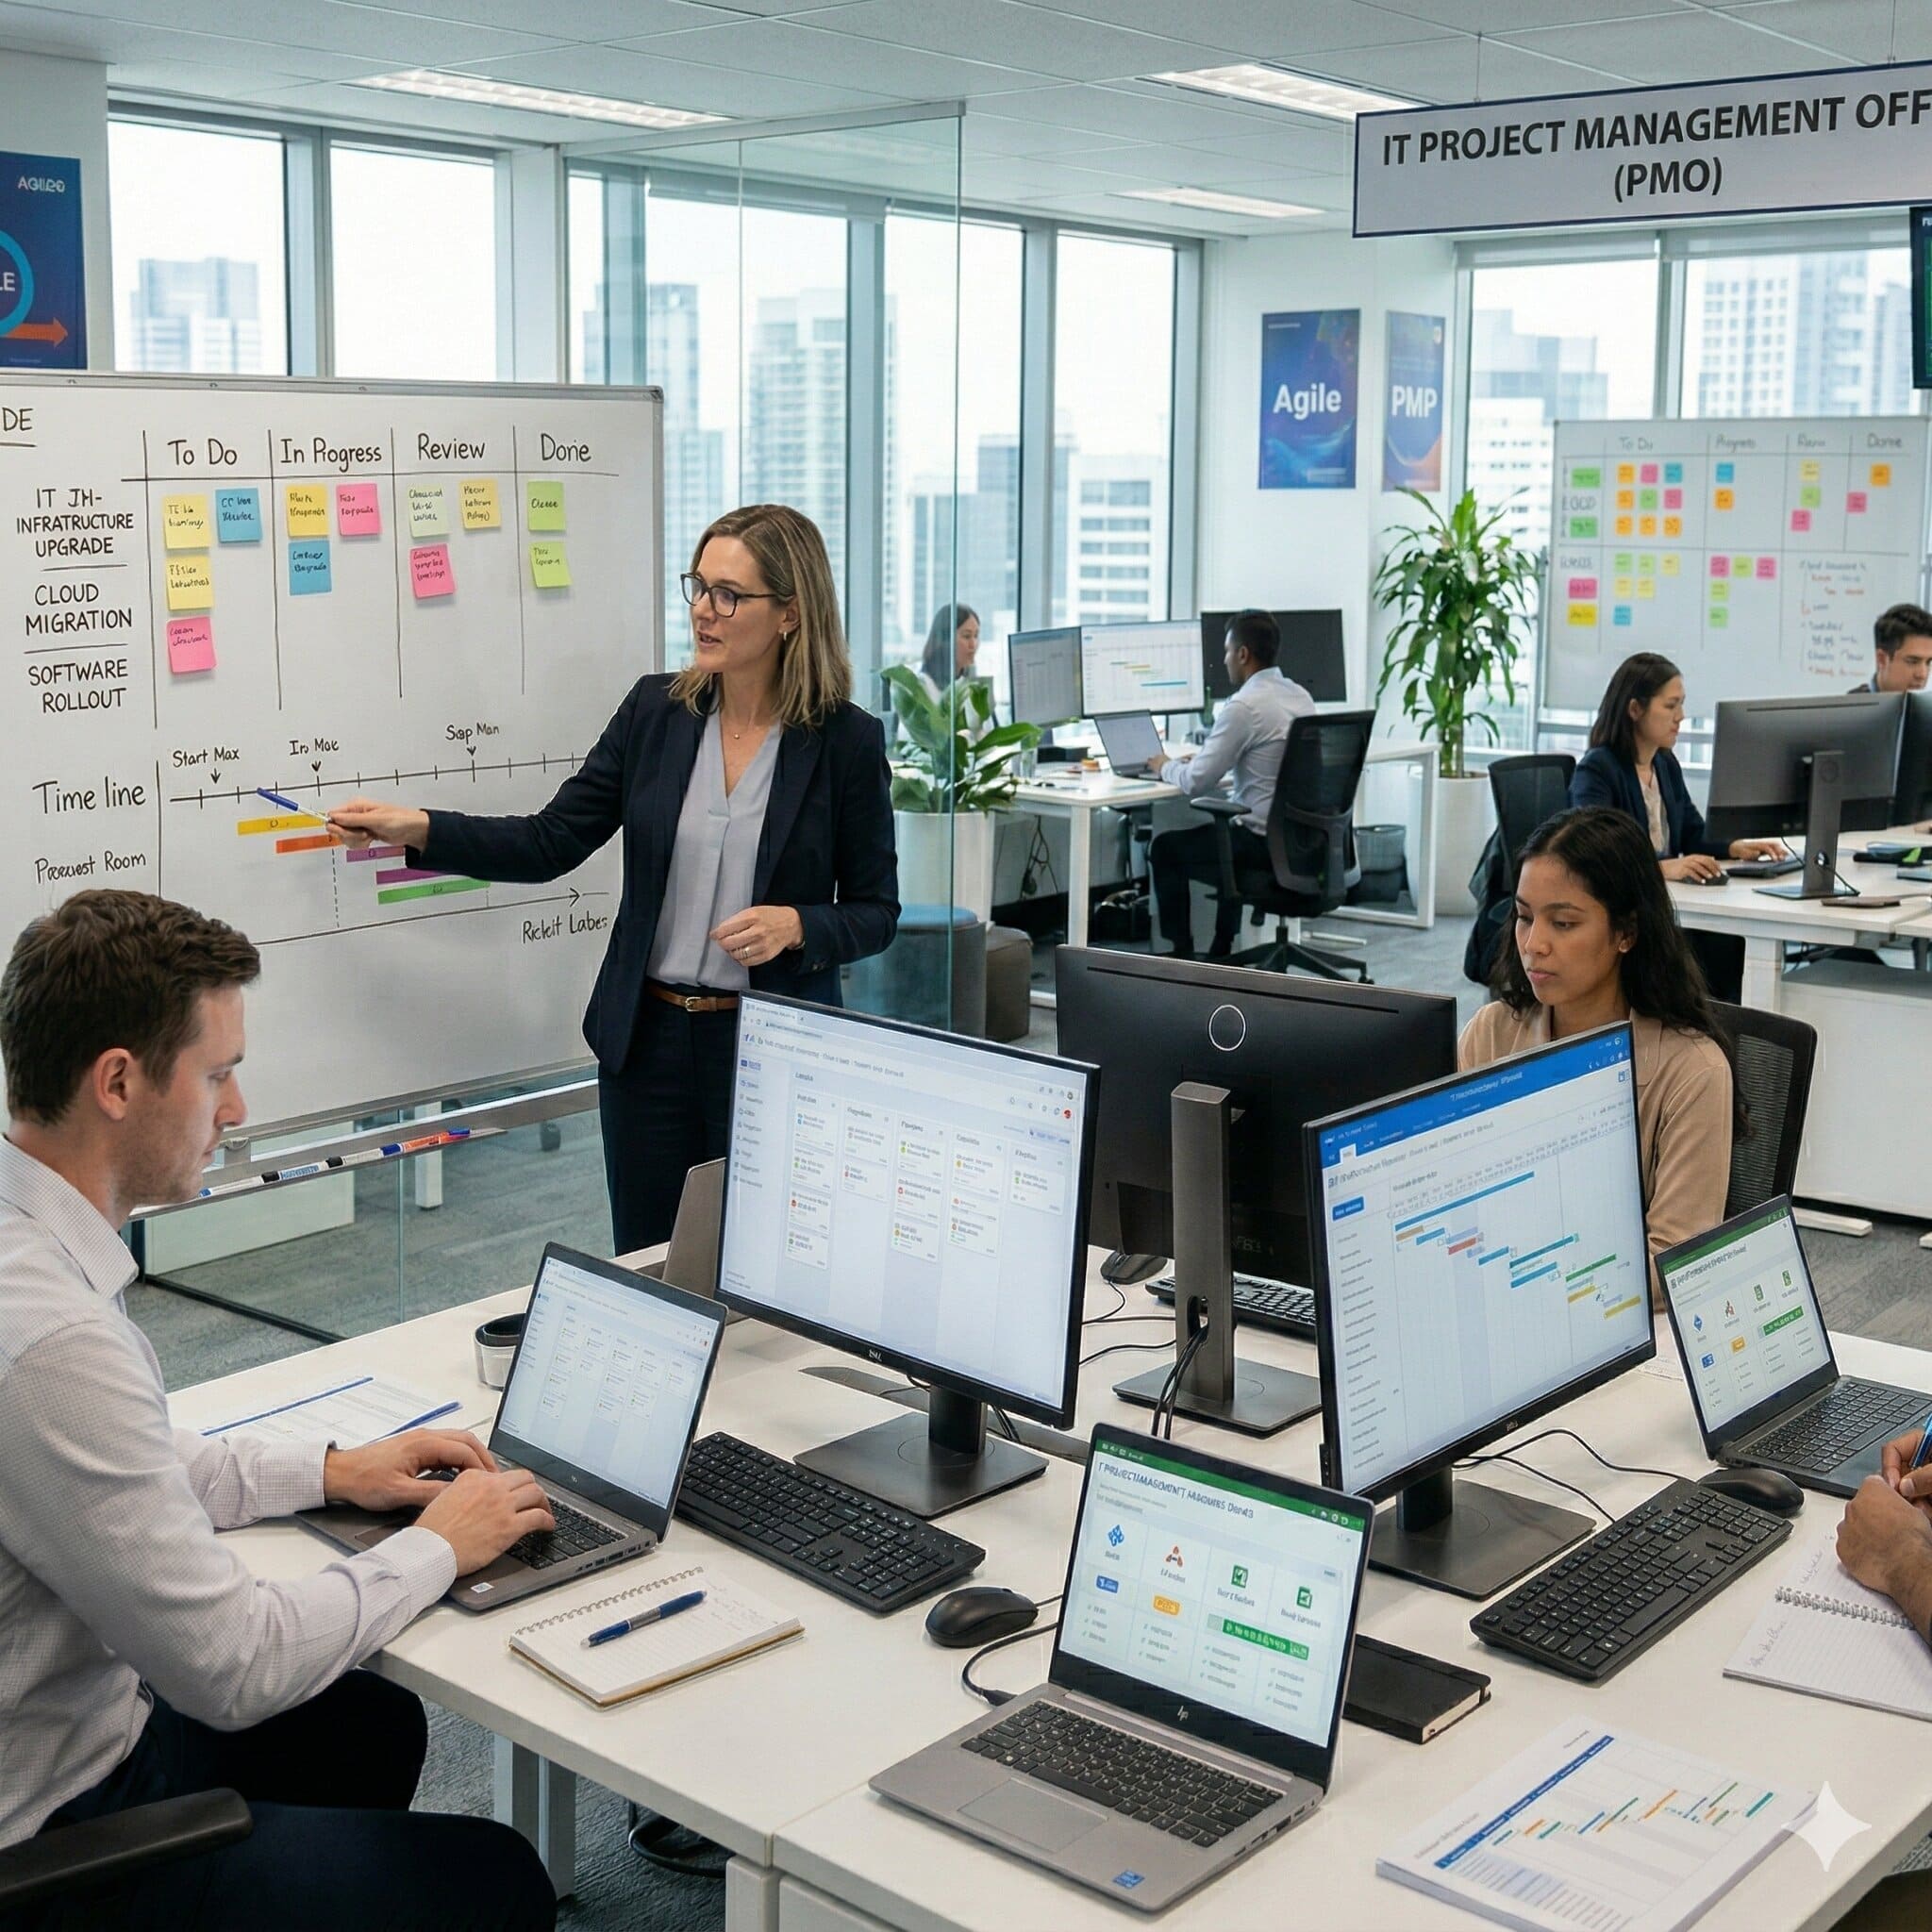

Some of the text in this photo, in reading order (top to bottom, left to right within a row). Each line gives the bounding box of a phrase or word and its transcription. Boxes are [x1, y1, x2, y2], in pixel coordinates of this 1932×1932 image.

[1383, 88, 1932, 165] IT PROJECT MANAGEMENT OFF
[1614, 157, 1723, 203] (PMO)
[1274, 382, 1342, 420] Agile
[1391, 385, 1438, 418] PMP
[2, 407, 34, 432] DE
[167, 438, 238, 466] To Do
[280, 437, 383, 473] In Progress
[418, 433, 486, 460] Review
[541, 433, 592, 462] Done
[37, 488, 57, 508] IT
[17, 513, 134, 535] INFRATRUCTURE
[36, 537, 114, 558] UPGRADE
[35, 583, 99, 607] CLOUD
[25, 608, 132, 636] MIGRATION
[28, 658, 129, 687] SOFTWARE
[42, 687, 127, 714] ROLLOUT
[173, 749, 208, 768] Start
[32, 775, 146, 814] Time line
[104, 850, 146, 872] Room
